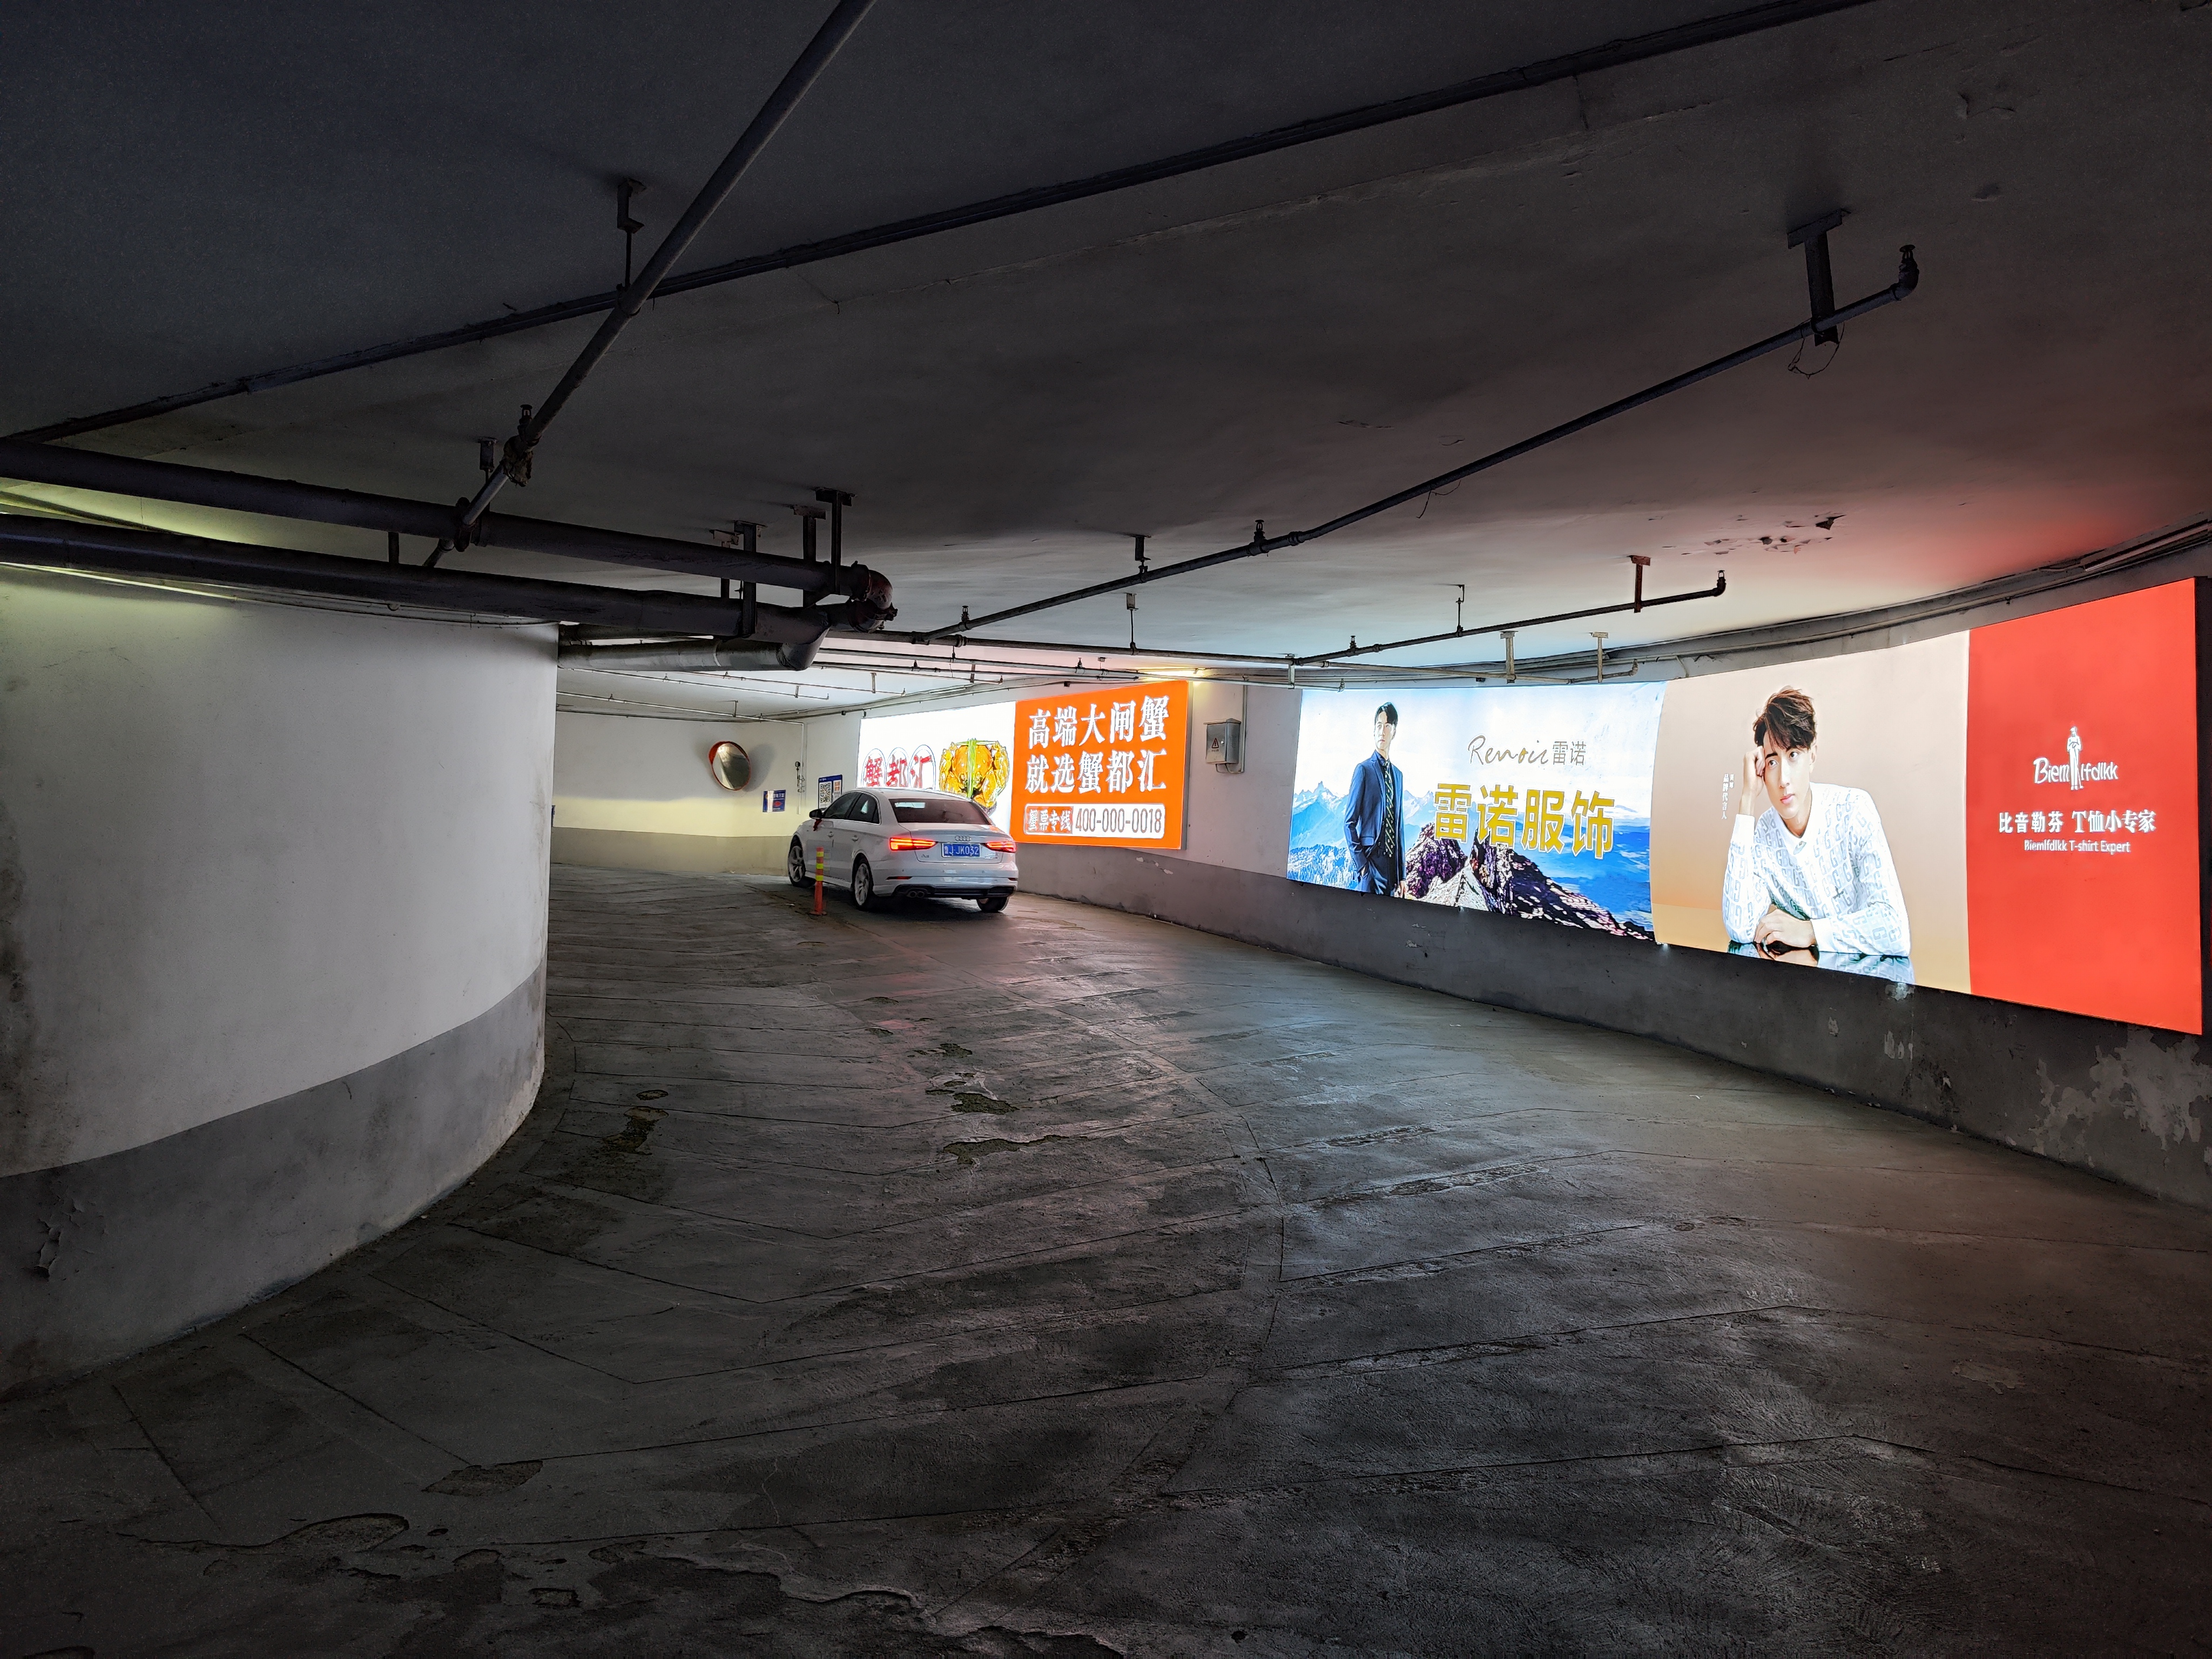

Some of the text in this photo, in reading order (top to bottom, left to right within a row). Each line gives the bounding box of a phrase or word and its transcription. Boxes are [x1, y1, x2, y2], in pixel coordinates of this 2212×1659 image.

[1028, 695, 1170, 750] 高端大闸蟹
[1552, 740, 1587, 765] 雷诺
[1024, 748, 1167, 794] 就选蟹都汇
[1075, 808, 1162, 833] 400-000-0018
[1434, 783, 1615, 859] 雷诺服饰
[1999, 810, 2156, 833] 比音勒芬 T恤小专家
[2069, 840, 2099, 852] T-shirt
[2100, 840, 2131, 855] Expert
